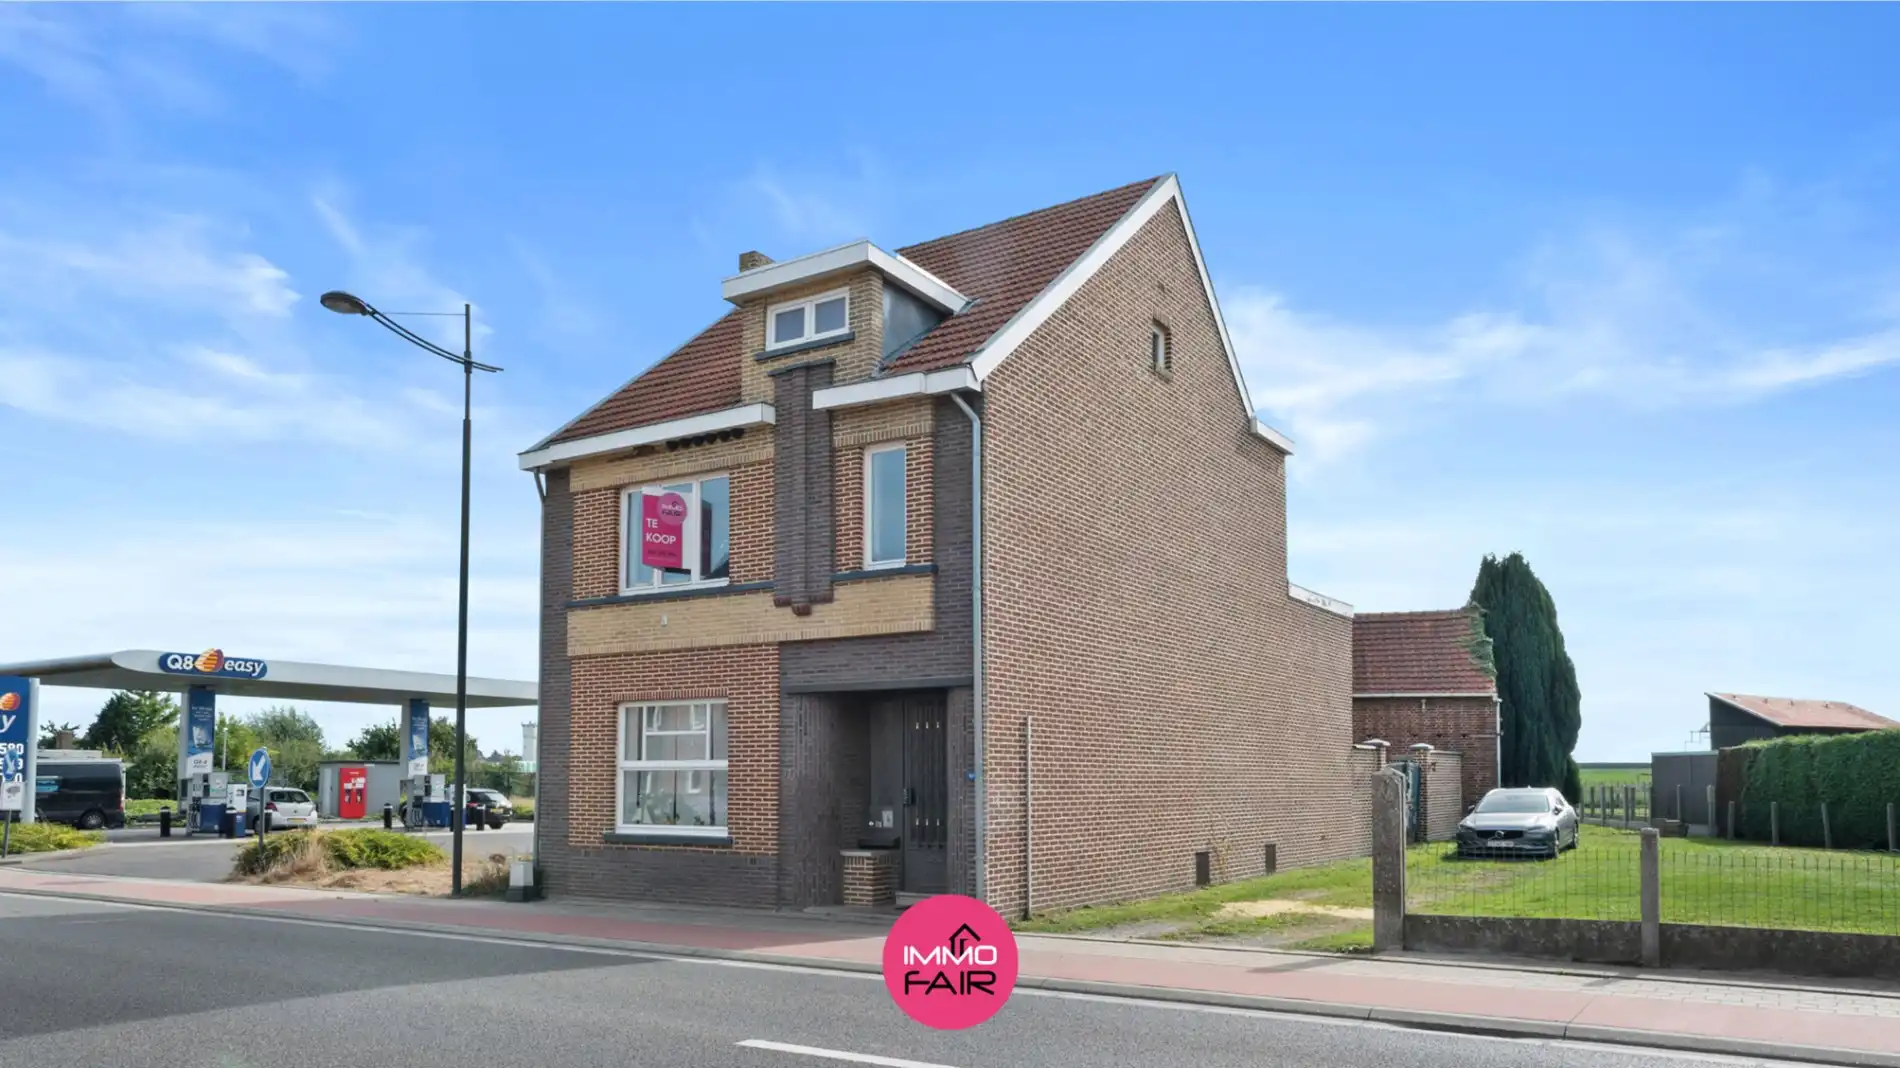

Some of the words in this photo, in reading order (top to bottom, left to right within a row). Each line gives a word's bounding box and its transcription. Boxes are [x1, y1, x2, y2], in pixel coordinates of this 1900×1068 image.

[645, 517, 659, 528] TE
[645, 532, 676, 544] KOOP
[166, 654, 194, 671] Q8
[224, 659, 265, 677] easy
